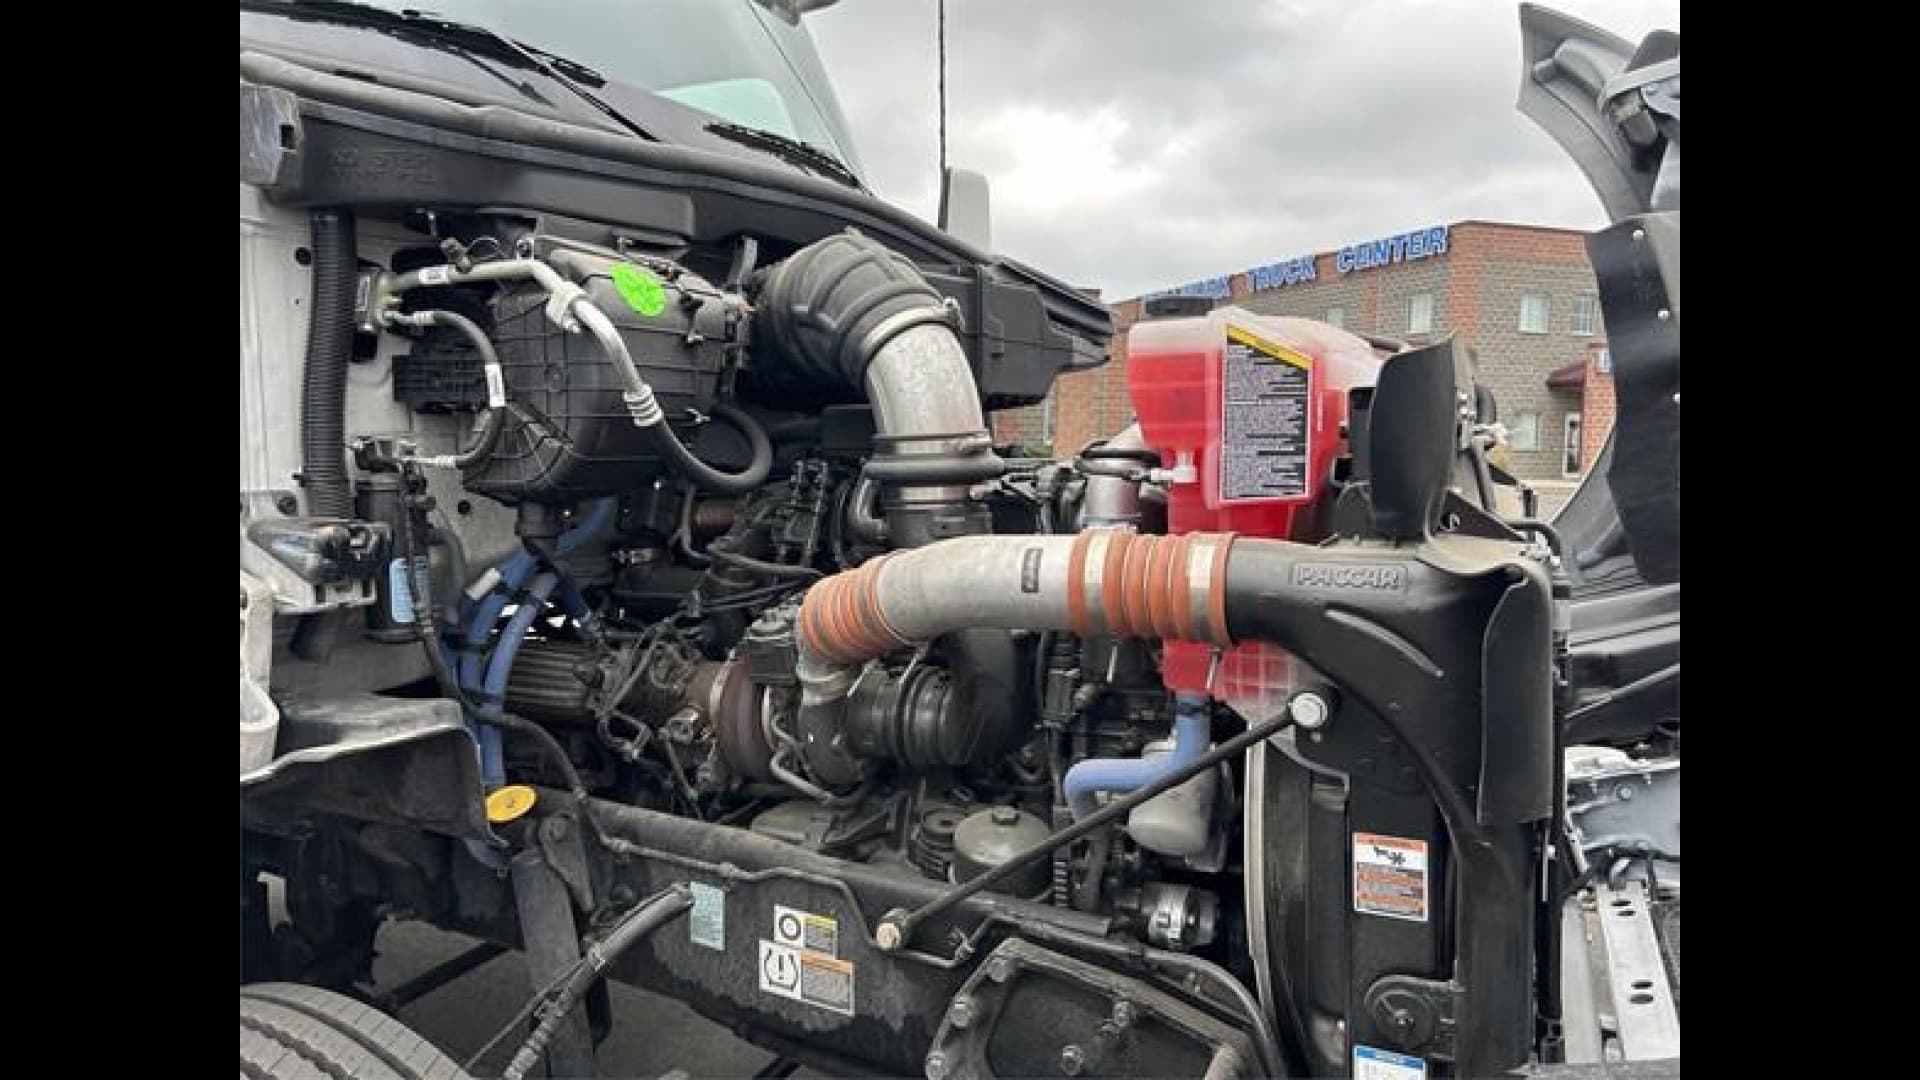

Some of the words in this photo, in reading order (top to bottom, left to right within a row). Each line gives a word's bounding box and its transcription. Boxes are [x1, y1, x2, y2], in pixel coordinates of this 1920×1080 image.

[1246, 255, 1317, 294] TRUCK
[1336, 225, 1447, 274] CENTER
[1297, 566, 1400, 590] PACCAR
